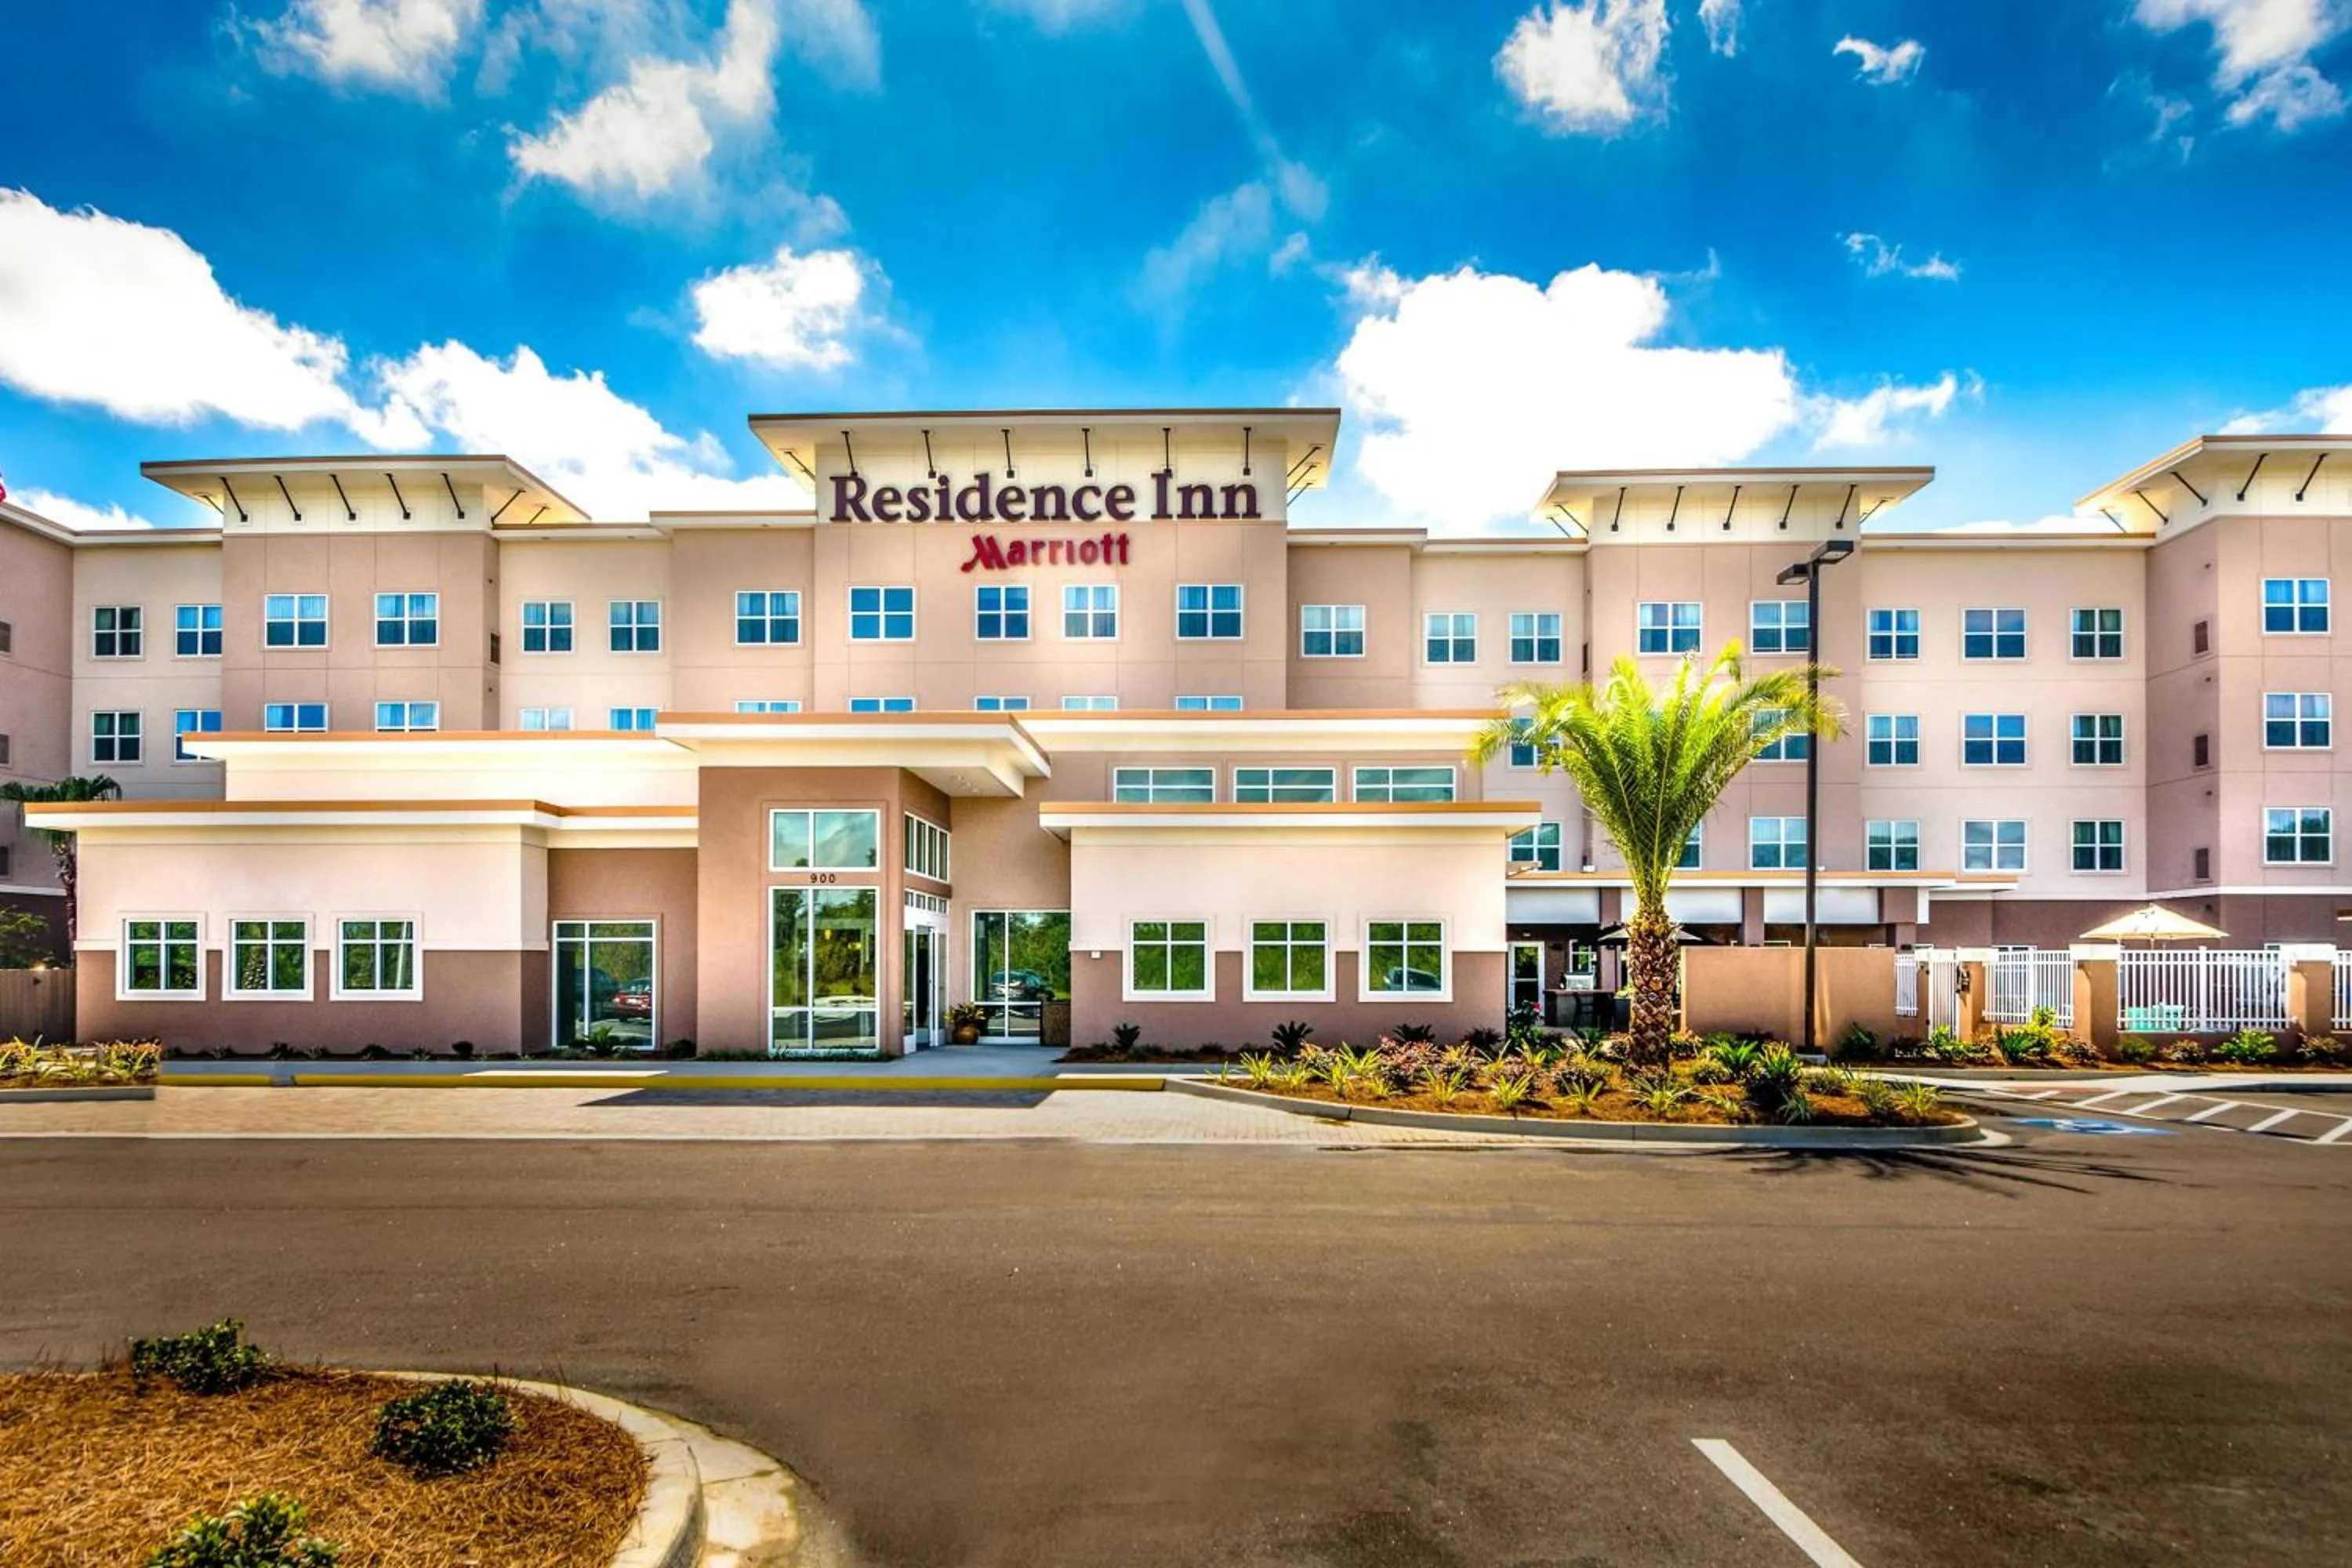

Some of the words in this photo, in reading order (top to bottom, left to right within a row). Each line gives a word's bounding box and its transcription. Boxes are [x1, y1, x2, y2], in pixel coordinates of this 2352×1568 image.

[829, 472, 1135, 524] Residence
[1151, 472, 1261, 521] Inn
[960, 533, 1130, 573] Marriott
[810, 873, 836, 884] 900
